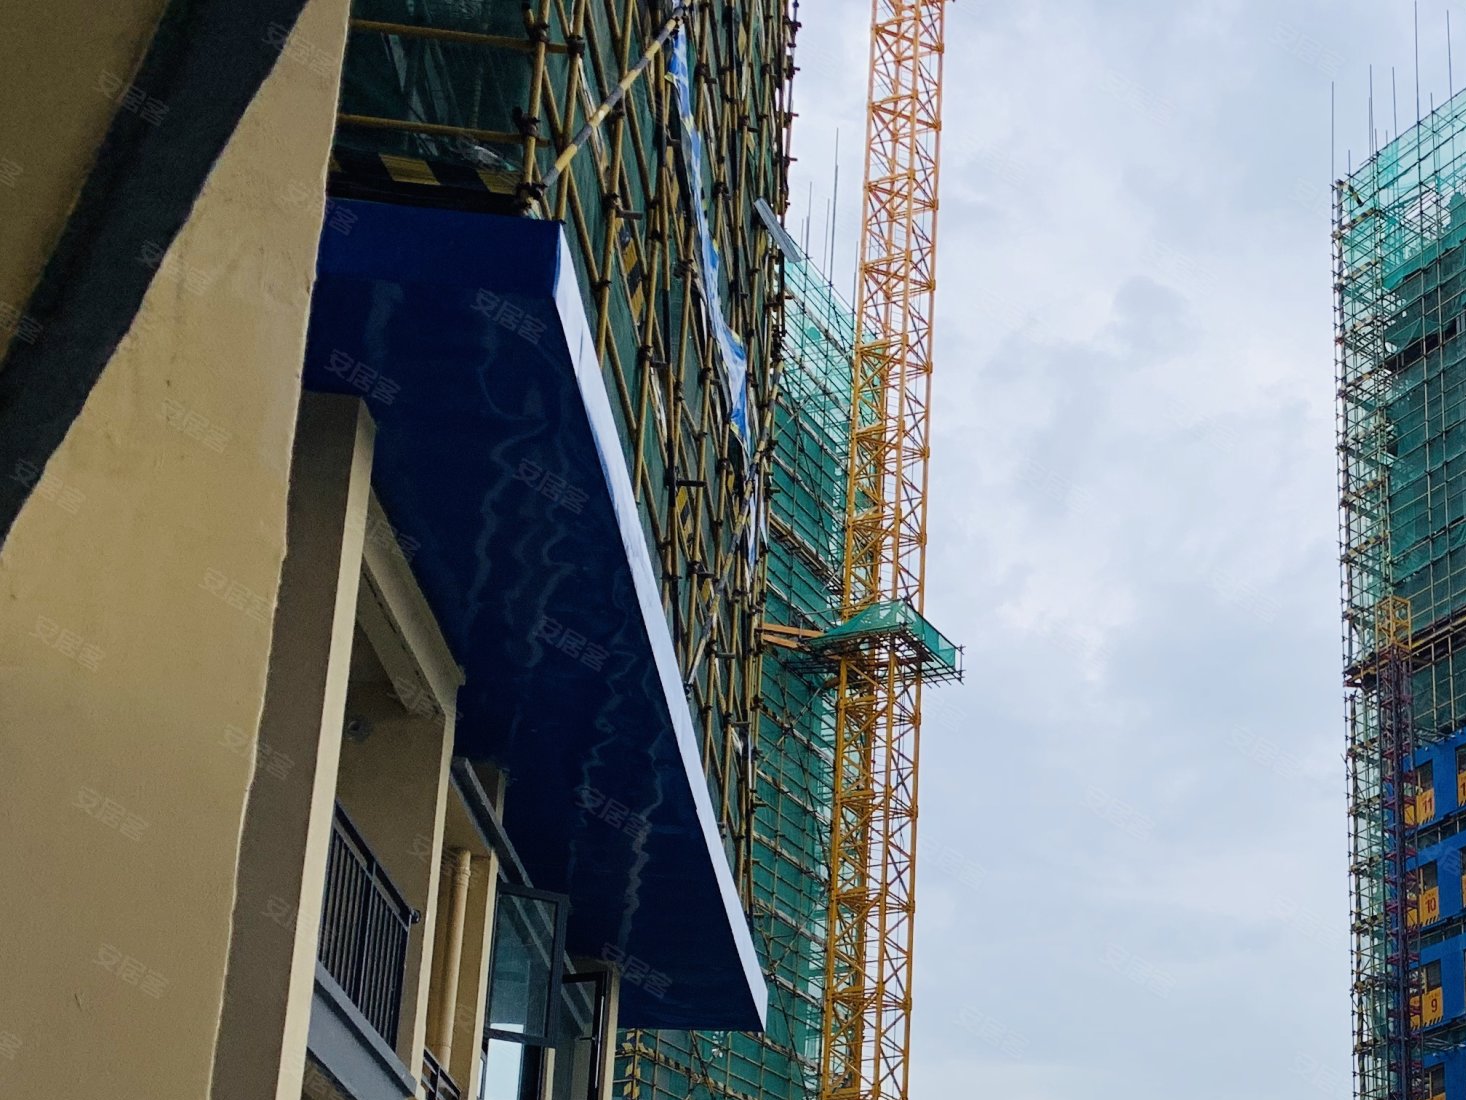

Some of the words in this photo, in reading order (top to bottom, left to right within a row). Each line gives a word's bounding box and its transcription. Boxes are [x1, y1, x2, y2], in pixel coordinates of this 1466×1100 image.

[1422, 797, 1433, 814] 11
[1425, 897, 1437, 914] 10
[1431, 998, 1438, 1013] 9
